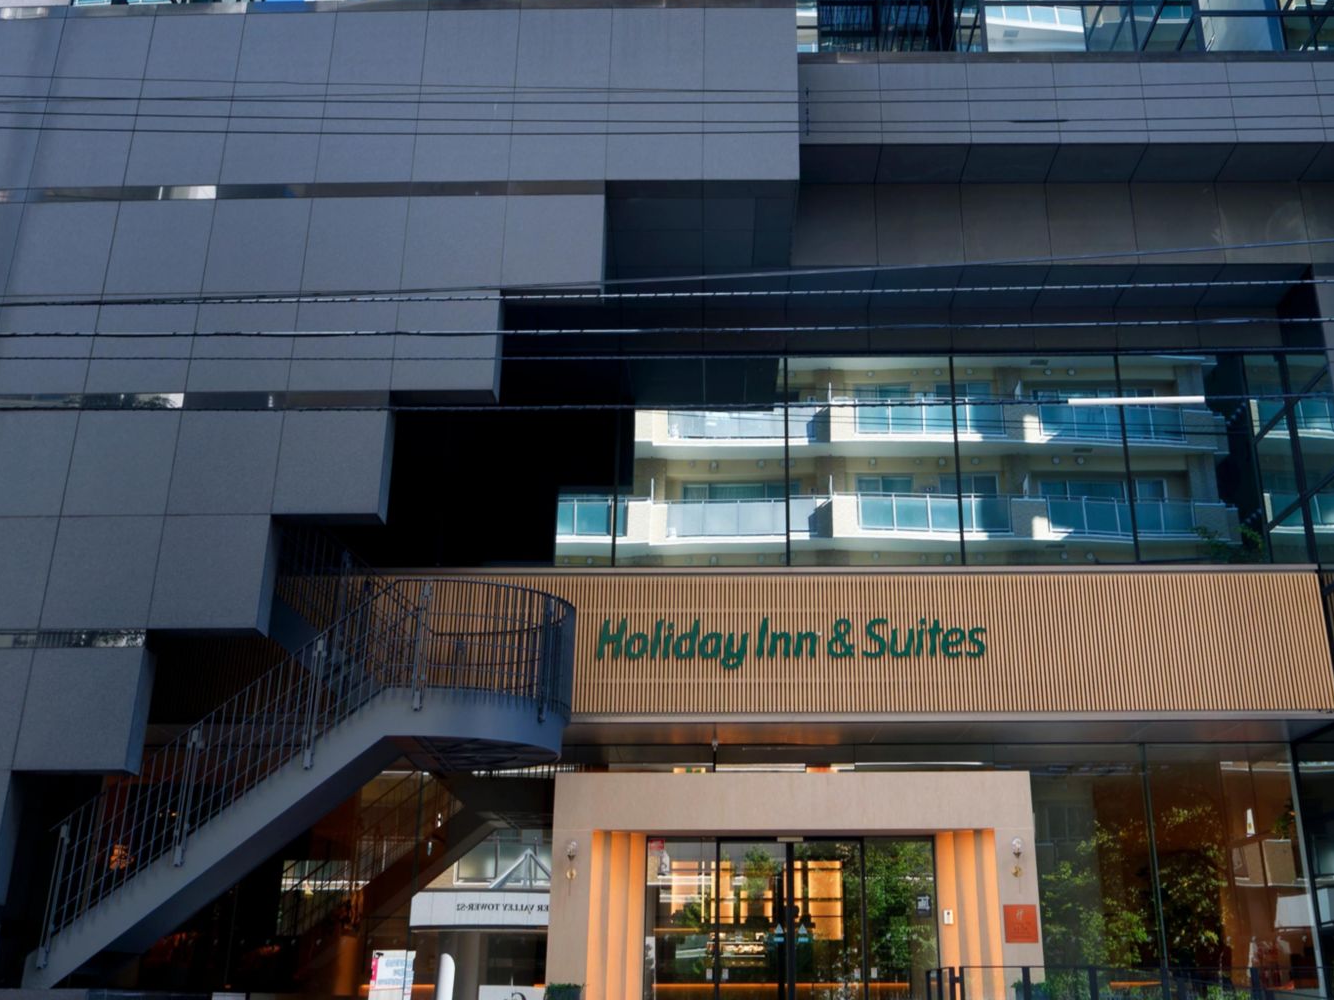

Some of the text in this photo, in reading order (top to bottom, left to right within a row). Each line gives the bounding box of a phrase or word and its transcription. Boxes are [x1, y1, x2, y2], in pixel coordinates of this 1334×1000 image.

[597, 617, 987, 670] Holiday Inn & Suites
